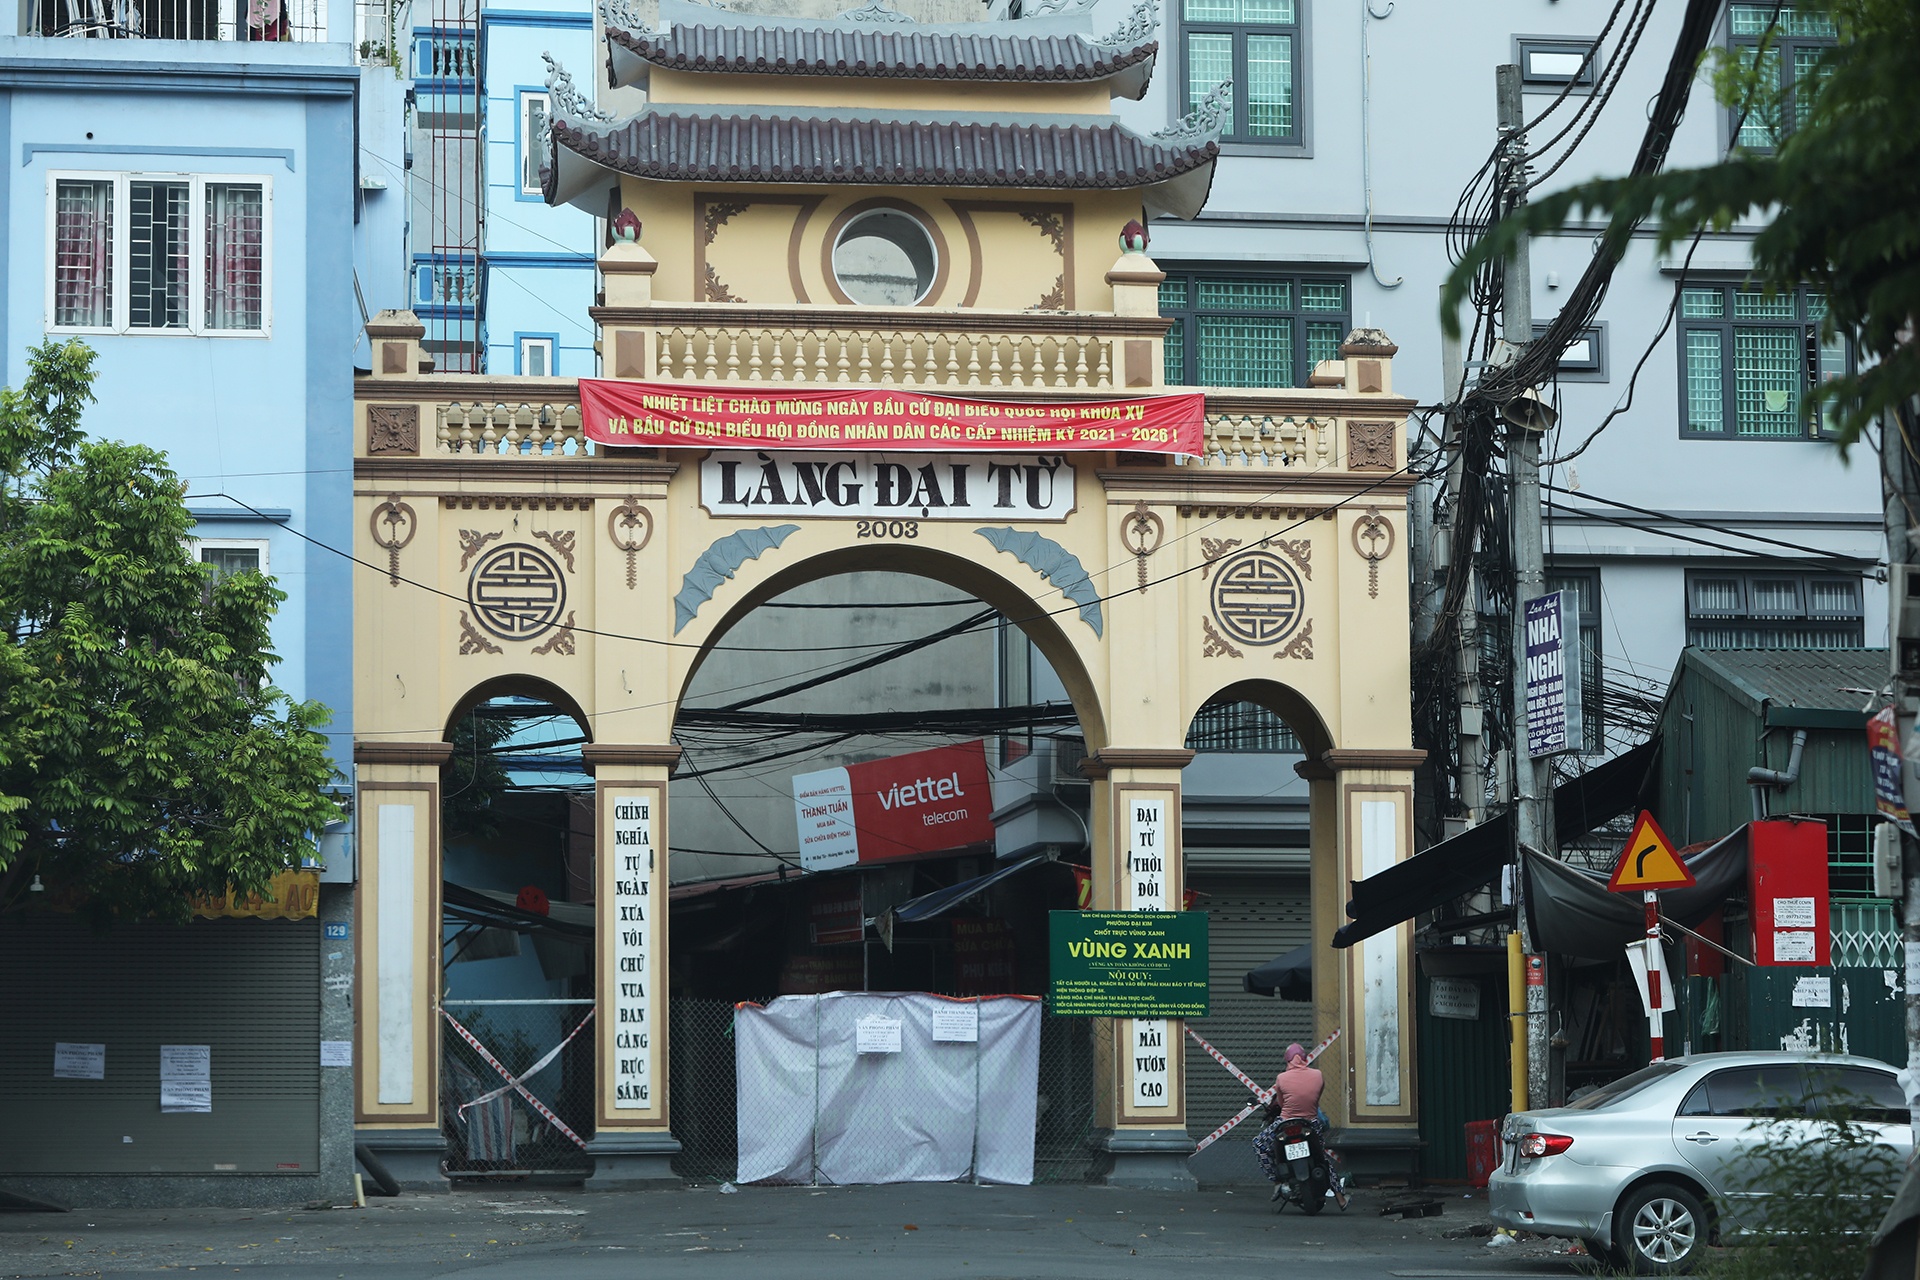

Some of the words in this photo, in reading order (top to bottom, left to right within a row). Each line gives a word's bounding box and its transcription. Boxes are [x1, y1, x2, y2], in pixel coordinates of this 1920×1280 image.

[642, 394, 688, 412] NHIỆT
[693, 396, 724, 415] LIỆT
[729, 398, 770, 414] CHÀO
[776, 398, 822, 416] MỪNG
[827, 398, 869, 416] NGÀY
[874, 396, 904, 416] BẦU
[909, 398, 931, 416] CỬ
[934, 401, 960, 420] ĐẠI
[1125, 405, 1145, 420] XV
[608, 415, 628, 435] VÀ
[633, 414, 665, 435] BẦU
[669, 416, 692, 435] CỬ
[695, 422, 721, 439] ĐẠI
[726, 418, 762, 438] BIỂU
[766, 421, 792, 441] HỘI
[796, 420, 840, 439] ĐỒNG
[844, 422, 888, 439] NHÂN
[893, 422, 925, 439] DÂN
[930, 422, 960, 440] CÁC
[966, 422, 996, 440] CẤP
[1001, 424, 1052, 444] NHIỆM
[1056, 426, 1076, 441] KỲ
[1080, 428, 1115, 441] 2021
[1132, 428, 1168, 442] 2026
[717, 452, 864, 508] LÀNG
[873, 461, 971, 518] ĐẠI
[987, 455, 1062, 510] TỪ
[856, 520, 919, 539] 2003
[1528, 608, 1560, 647] NHÀ
[1527, 638, 1562, 684] NGHỈ
[877, 772, 965, 811] viettel
[616, 802, 649, 820] CHÍNH
[801, 805, 827, 818] THANH
[828, 796, 848, 814] TUẤN
[922, 808, 968, 826] telecom
[1137, 808, 1158, 826] ĐẠI
[616, 826, 649, 845] NGHĨA
[1140, 828, 1156, 846] TỪ
[624, 854, 640, 876] TỰ
[1134, 852, 1162, 872] THỜI
[616, 878, 648, 896] NGÀN
[1138, 874, 1159, 896] ĐỔI
[620, 904, 644, 921] XƯA
[327, 925, 346, 936] 129
[622, 928, 643, 946] VỚI
[1094, 928, 1111, 936] CHỐT
[1068, 937, 1127, 958] VÙNG
[1133, 942, 1190, 959] XANH
[620, 954, 644, 972] CHỮ
[1108, 970, 1126, 981] NỘI
[1128, 971, 1152, 981] QUY:
[621, 983, 644, 998] VUA
[620, 1008, 644, 1022] BAN
[617, 1030, 648, 1048] CÀNG
[1139, 1028, 1162, 1046] MÃI
[620, 1057, 644, 1078] RỰC
[1136, 1055, 1166, 1072] VƯƠN
[617, 1081, 648, 1100] SÁNG
[1141, 1082, 1162, 1097] CAO
